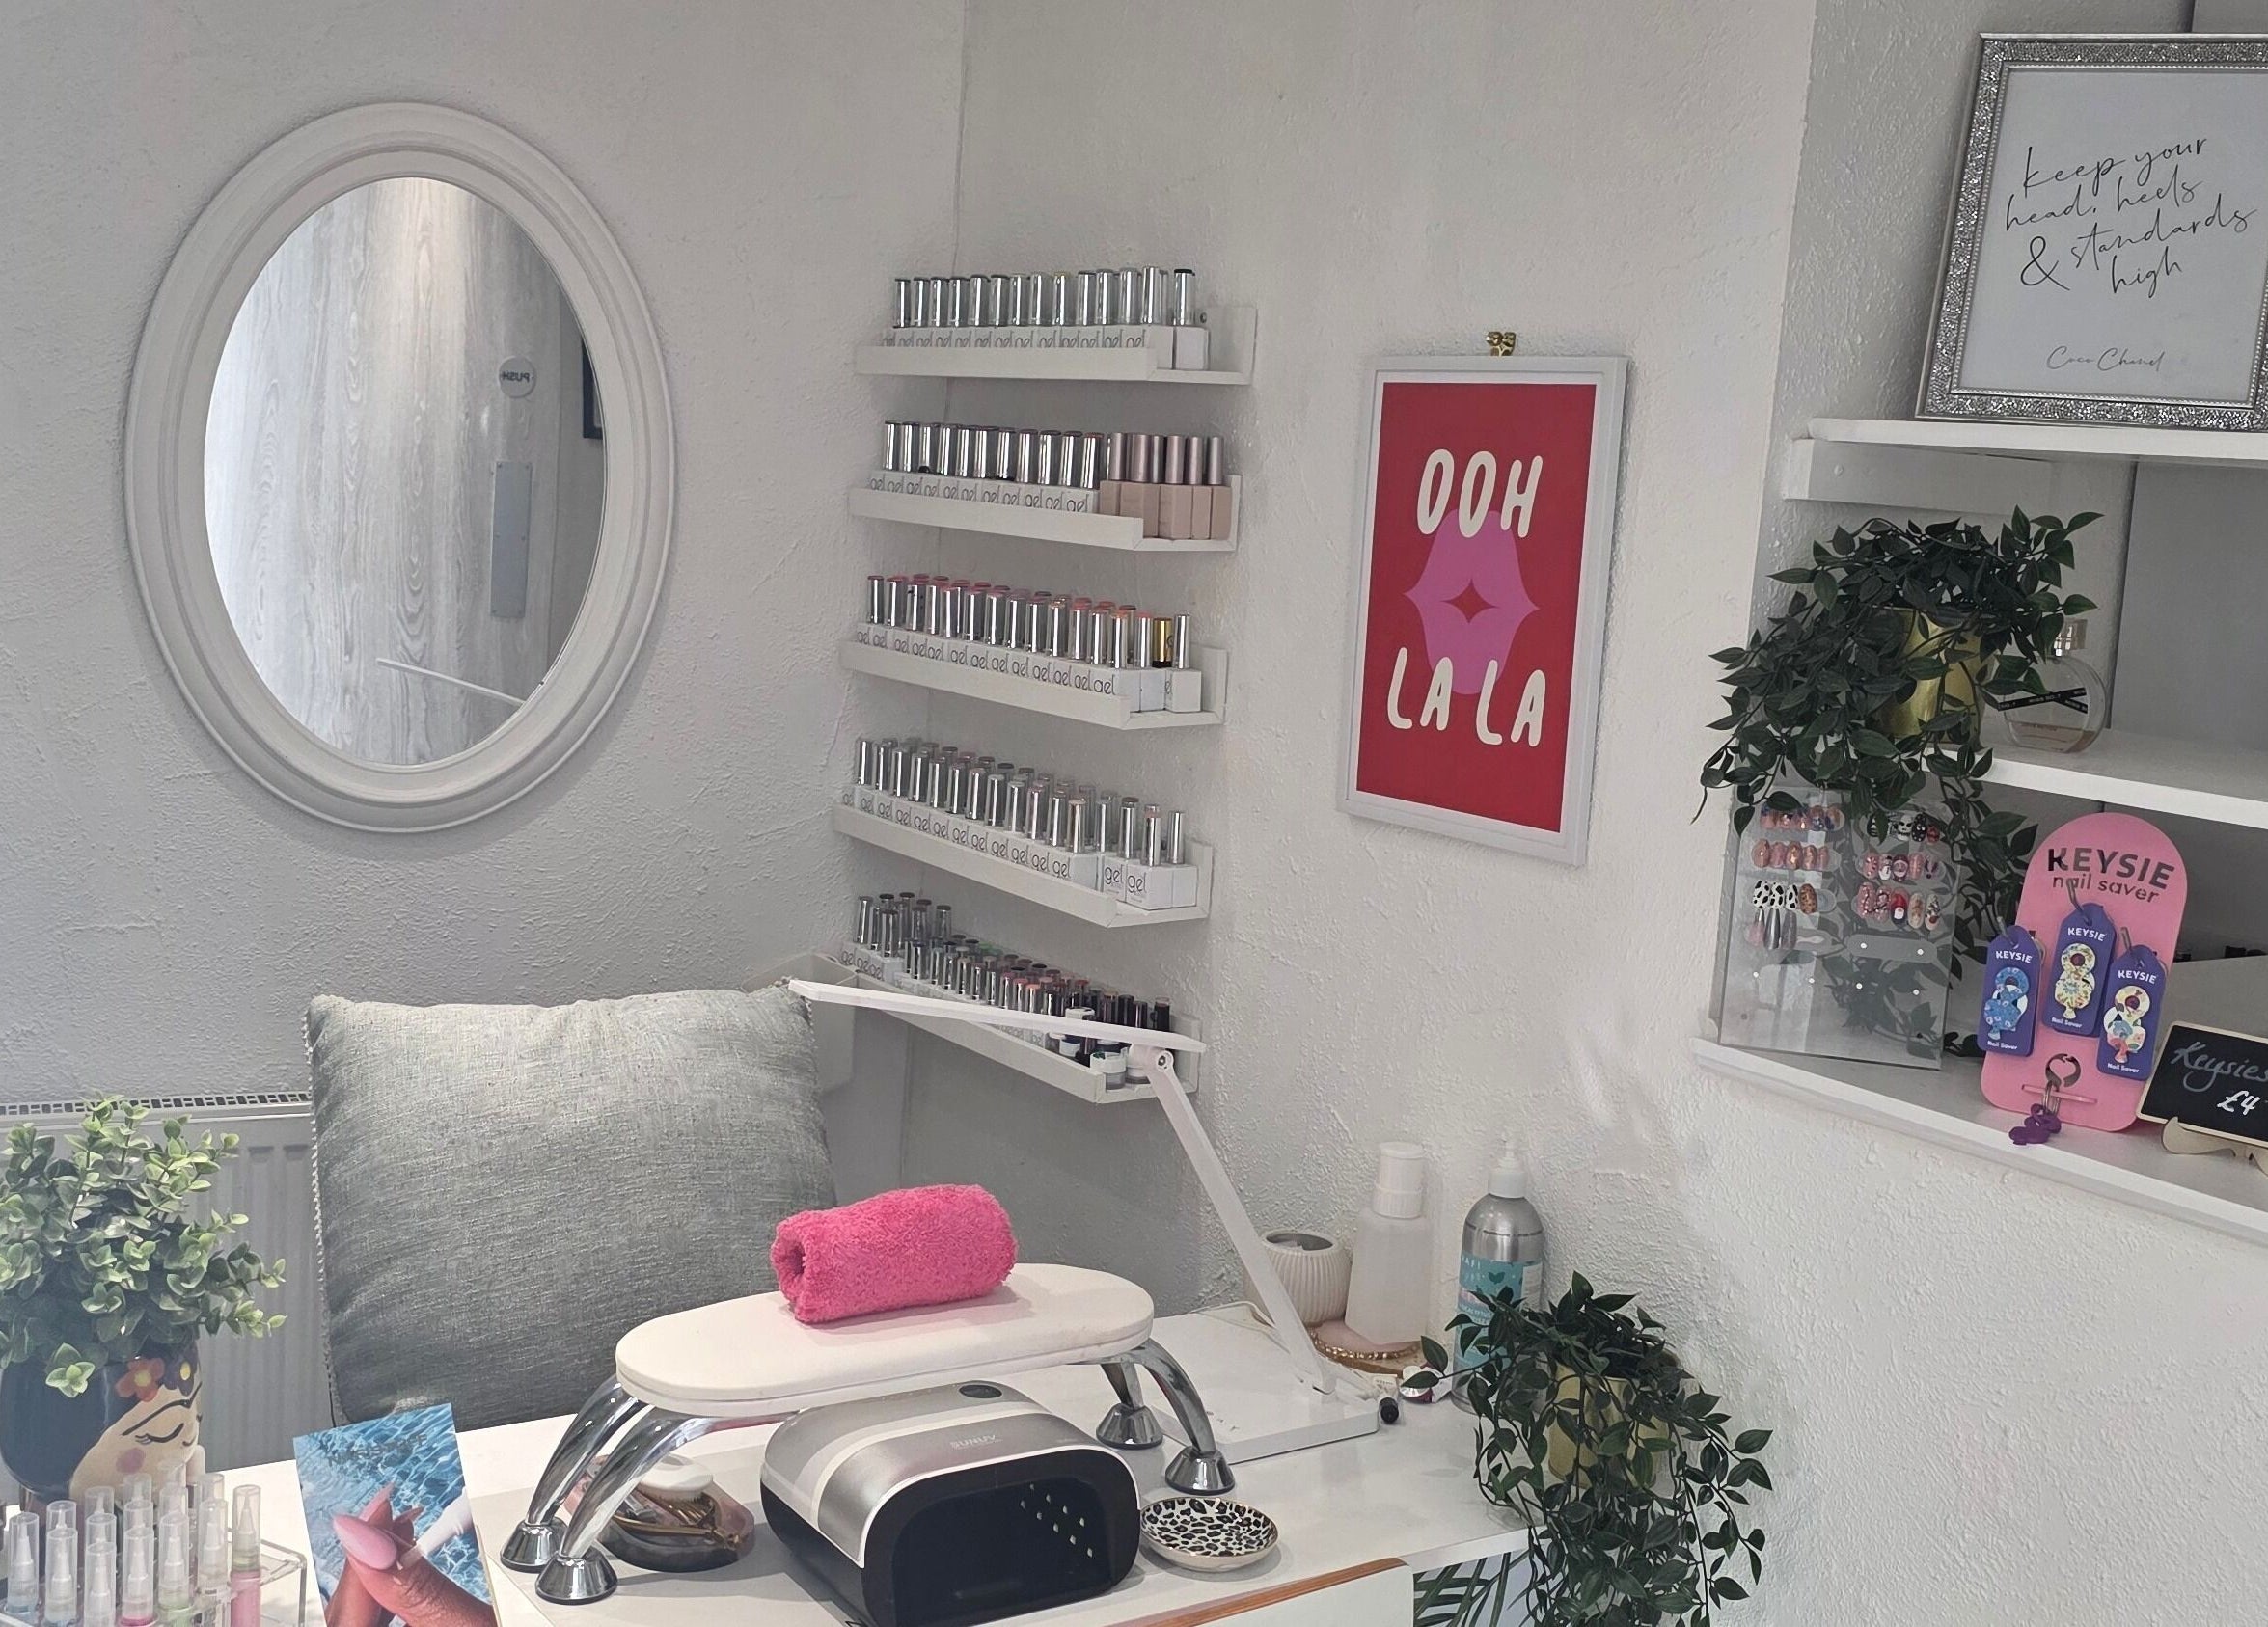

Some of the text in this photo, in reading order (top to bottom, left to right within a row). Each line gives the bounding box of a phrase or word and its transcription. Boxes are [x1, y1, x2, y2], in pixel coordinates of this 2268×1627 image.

[2023, 138, 2207, 199] keep your
[2117, 164, 2204, 211] heels
[2020, 193, 2258, 290] & standards
[2111, 245, 2182, 299] high
[1416, 448, 1544, 538] OOH
[1386, 646, 1546, 747] LA LA
[1104, 863, 1125, 885] gel
[1127, 871, 1148, 894] gel
[2047, 847, 2175, 890] KEYSIE
[2053, 873, 2160, 903] nail saver
[2067, 927, 2106, 941] KEYSIE
[1995, 950, 2033, 964] KEYSIE
[2118, 969, 2157, 985] KEYSIE
[2216, 1090, 2261, 1116] £4
